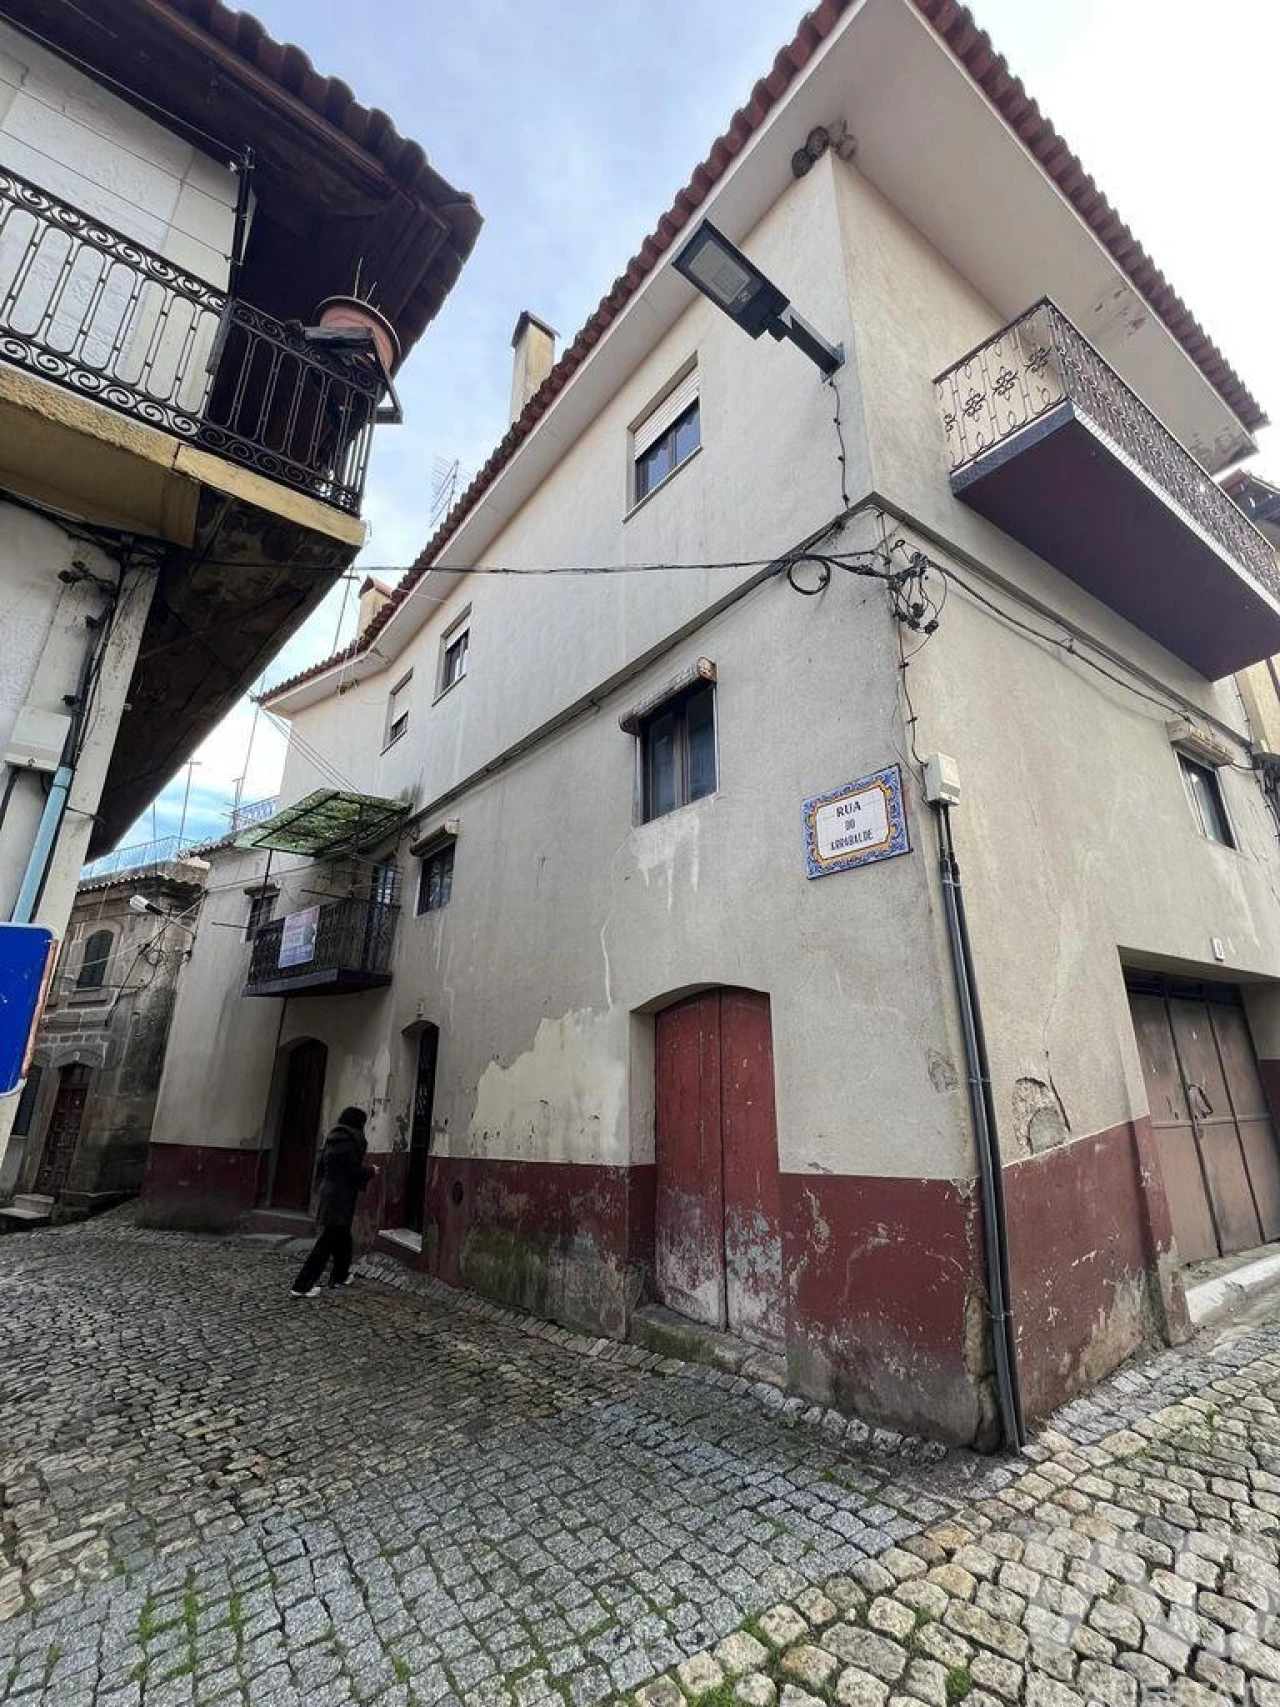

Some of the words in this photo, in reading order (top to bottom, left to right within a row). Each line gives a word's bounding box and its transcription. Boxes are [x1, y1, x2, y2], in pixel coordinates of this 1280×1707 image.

[836, 801, 862, 817] RUA
[845, 819, 855, 830] DO
[831, 829, 873, 850] ARRABALDE
